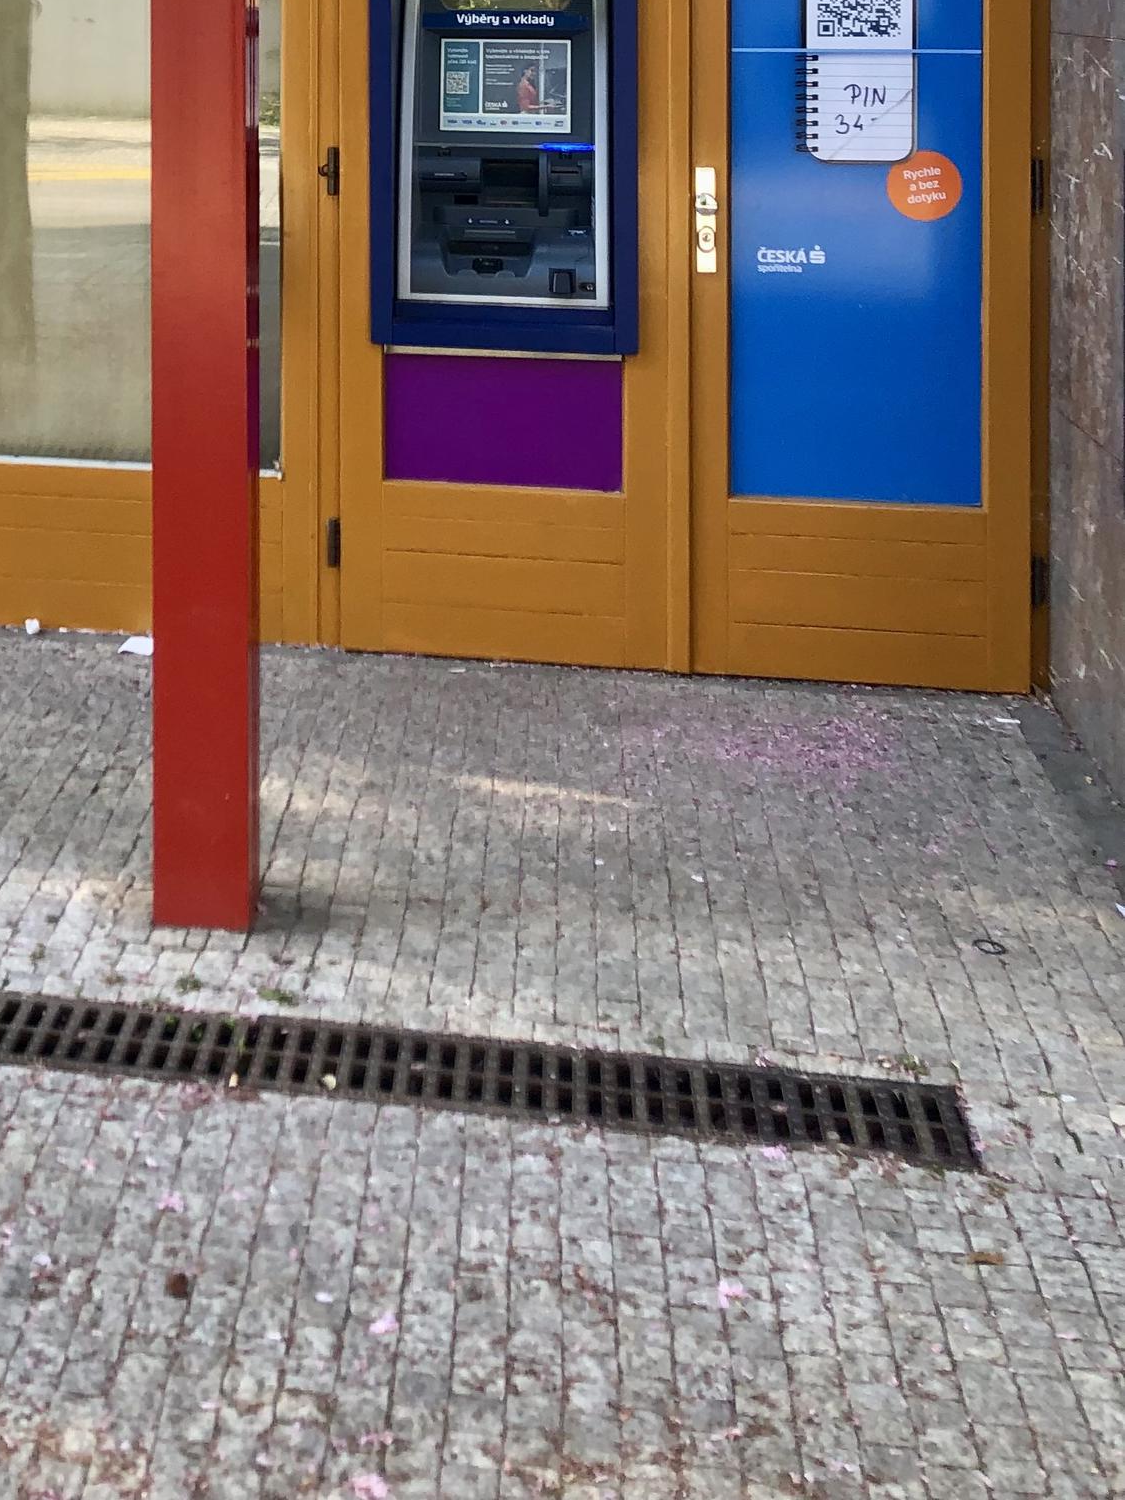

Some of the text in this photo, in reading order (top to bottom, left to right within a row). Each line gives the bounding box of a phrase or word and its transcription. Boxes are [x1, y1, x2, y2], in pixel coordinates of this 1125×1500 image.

[457, 13, 555, 27] Výběry a vklady
[843, 83, 886, 107] PIN
[903, 166, 942, 182] Rychle
[909, 180, 940, 192] a bez
[907, 190, 948, 205] dotyku
[757, 246, 807, 264] ČESKÁ
